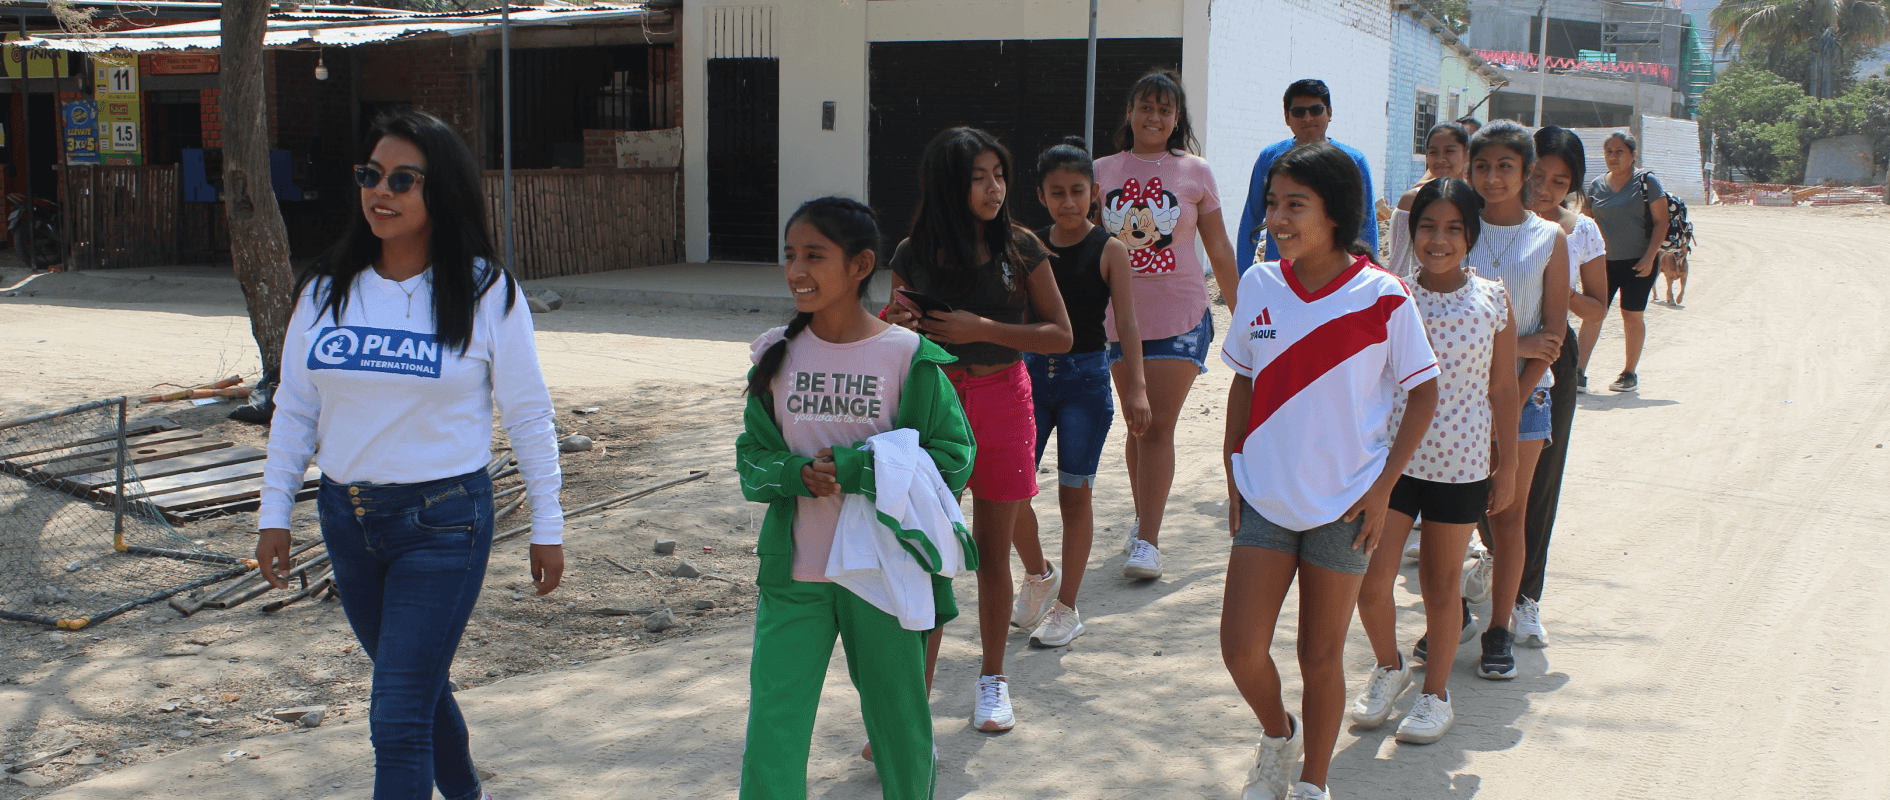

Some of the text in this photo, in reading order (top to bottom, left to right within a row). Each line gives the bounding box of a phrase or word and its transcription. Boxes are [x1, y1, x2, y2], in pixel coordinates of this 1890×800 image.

[113, 69, 130, 90] 11
[116, 125, 133, 141] 1.5
[362, 334, 438, 362] PLAN
[360, 359, 436, 374] INTERNATIONAL
[794, 371, 878, 396] BE THE
[786, 394, 882, 419] CHANGE
[793, 411, 873, 425] you want to see
